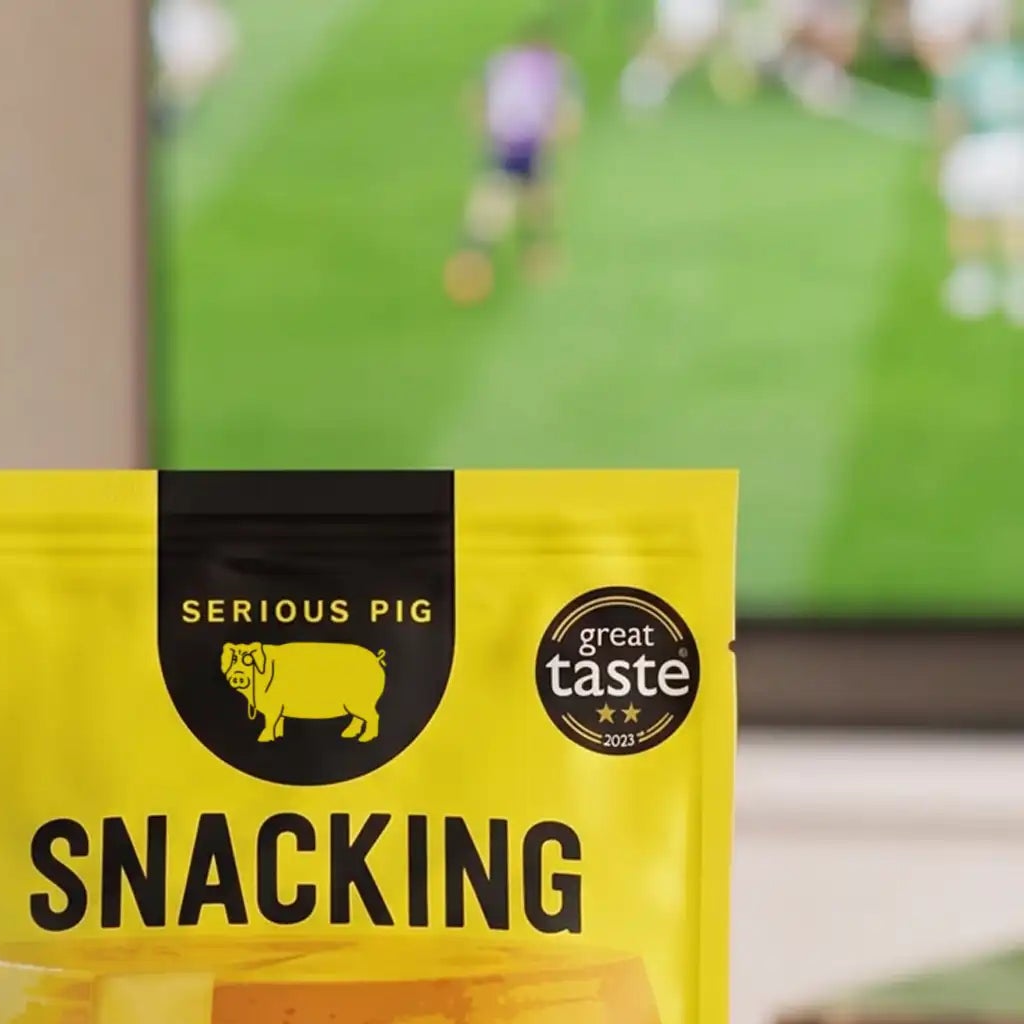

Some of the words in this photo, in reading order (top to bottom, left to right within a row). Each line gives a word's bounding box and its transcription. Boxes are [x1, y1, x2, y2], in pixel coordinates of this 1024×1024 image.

[181, 599, 349, 624] SERIOUS
[370, 599, 434, 624] PIG
[579, 624, 655, 657] great
[545, 653, 691, 697] taste
[603, 733, 636, 748] 2023
[29, 812, 584, 935] SNACKING
